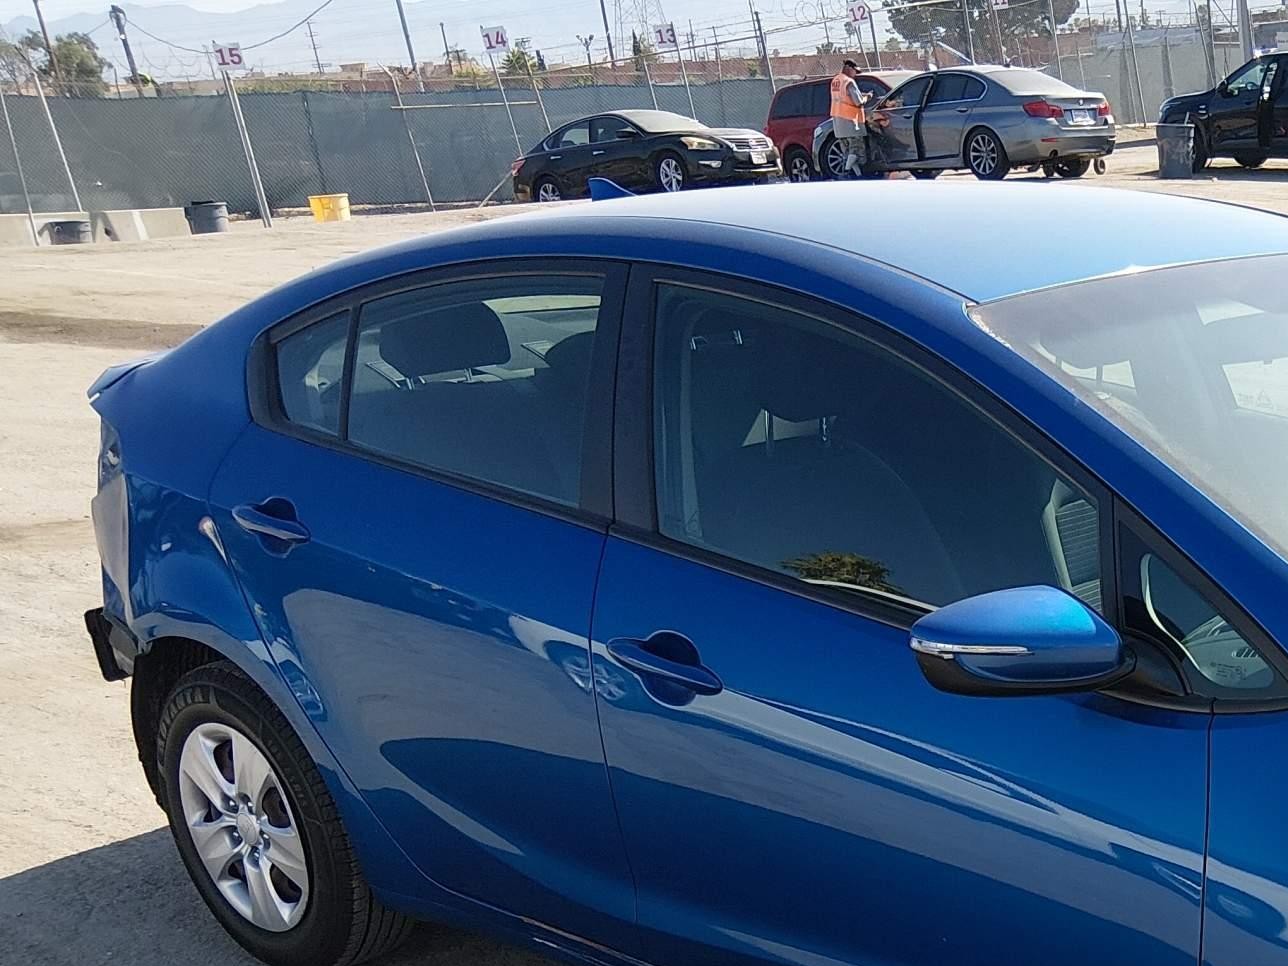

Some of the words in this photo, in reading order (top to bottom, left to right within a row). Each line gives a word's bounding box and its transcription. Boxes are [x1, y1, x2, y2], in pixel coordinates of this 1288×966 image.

[849, 5, 869, 23] 12
[482, 30, 507, 50] 14
[655, 28, 676, 44] 13
[215, 47, 242, 66] 15
